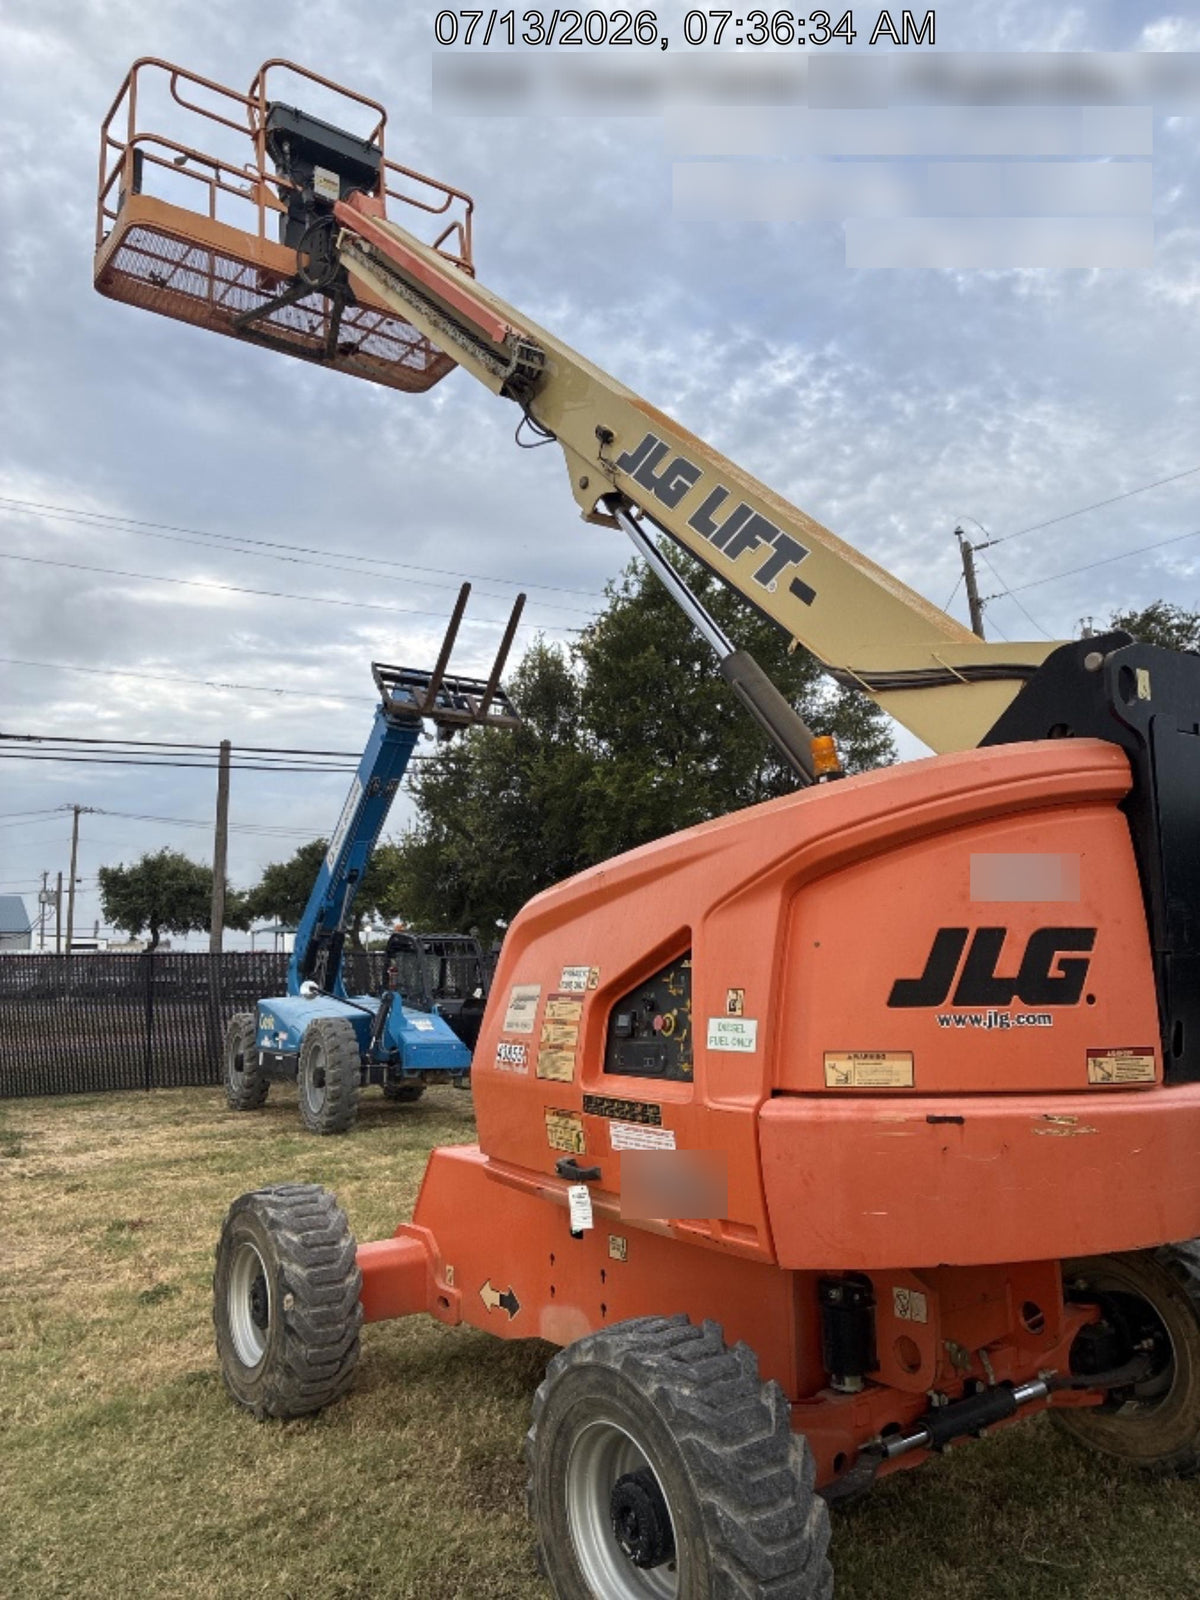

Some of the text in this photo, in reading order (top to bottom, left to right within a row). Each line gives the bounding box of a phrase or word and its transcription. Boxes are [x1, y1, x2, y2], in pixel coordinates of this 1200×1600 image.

[615, 432, 812, 592] JLG LIFT
[936, 1010, 1053, 1030] www.jlg.com
[709, 1035, 754, 1048] FUEL ONLY
